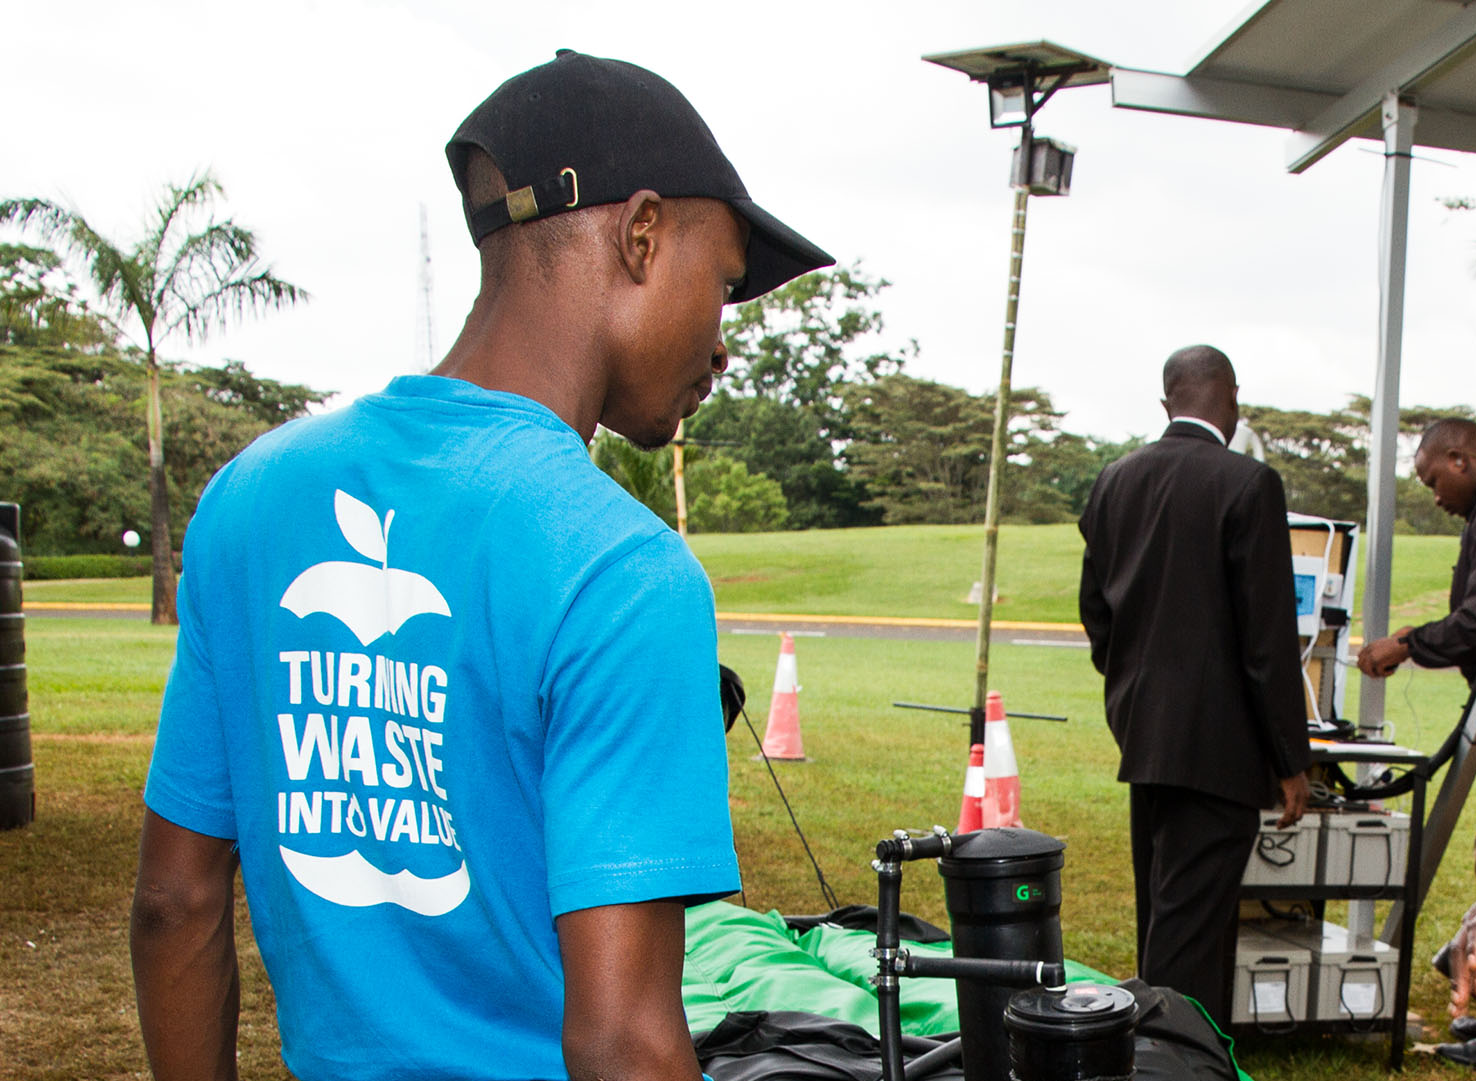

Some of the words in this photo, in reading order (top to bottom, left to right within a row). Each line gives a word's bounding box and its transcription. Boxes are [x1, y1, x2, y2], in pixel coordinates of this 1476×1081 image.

[279, 650, 448, 723] TURNING
[277, 713, 448, 801] WASTE
[278, 791, 367, 837] INTO
[368, 797, 462, 852] VALUE
